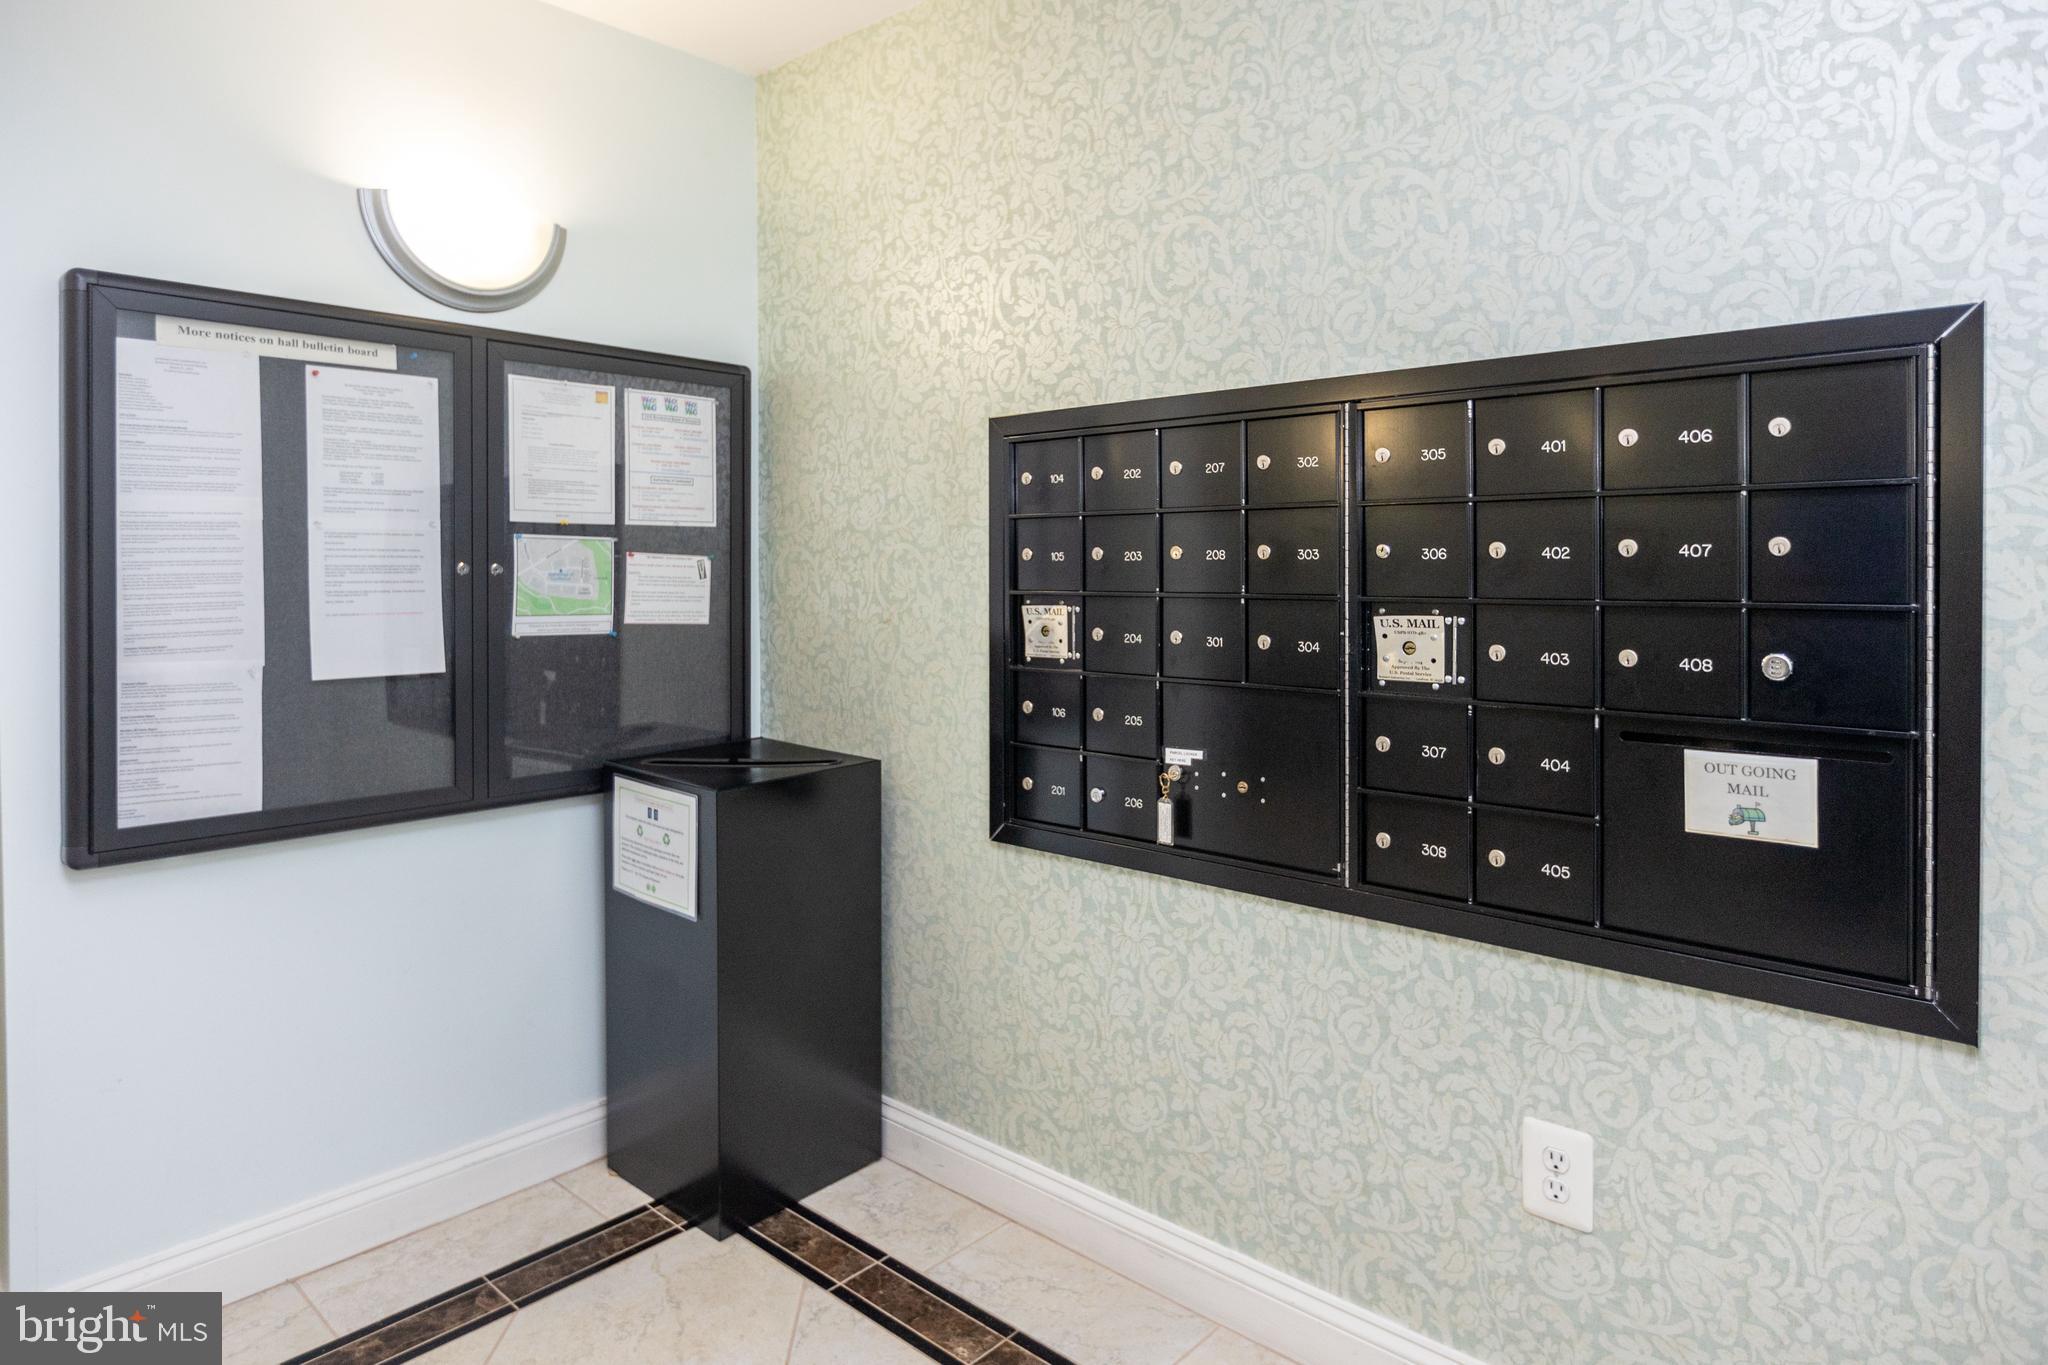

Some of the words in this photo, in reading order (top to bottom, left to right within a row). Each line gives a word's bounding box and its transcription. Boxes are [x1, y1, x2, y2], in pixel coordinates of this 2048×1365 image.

[178, 325, 211, 337] More
[216, 332, 256, 343] notices
[278, 337, 299, 348] hall
[303, 340, 344, 353] bulletin
[349, 346, 378, 357] board
[1678, 428, 1713, 444] 406
[1540, 439, 1566, 453] 401
[1420, 447, 1447, 462] 305
[1205, 462, 1225, 474] 207
[1296, 455, 1319, 469] 302
[1050, 473, 1065, 484] 104
[1123, 468, 1142, 480] 202
[1050, 551, 1065, 562] 105
[1124, 550, 1143, 562] 203
[1205, 549, 1226, 561] 208
[1297, 548, 1320, 560] 303
[1421, 547, 1447, 560] 306
[1541, 546, 1571, 560] 402
[1678, 543, 1713, 558] 407
[1026, 607, 1042, 615] U.S.
[1044, 607, 1064, 616] MAIL
[1380, 618, 1403, 628] U.S.
[1407, 618, 1440, 629] MAIL
[1124, 633, 1143, 644] 204
[1206, 636, 1223, 648] 301
[1297, 641, 1320, 653] 304
[1540, 652, 1570, 666] 403
[1678, 657, 1713, 673] 408
[1052, 707, 1066, 718] 106
[1124, 714, 1143, 727] 205
[1421, 745, 1447, 759] 307
[1540, 758, 1571, 773] 404
[1704, 762, 1738, 776] OUT
[1741, 765, 1797, 781] GOING
[1051, 784, 1066, 796] 201
[1727, 783, 1769, 798] MAIL
[1124, 796, 1143, 809] 206
[1421, 843, 1447, 859] 308
[1540, 863, 1571, 879] 405
